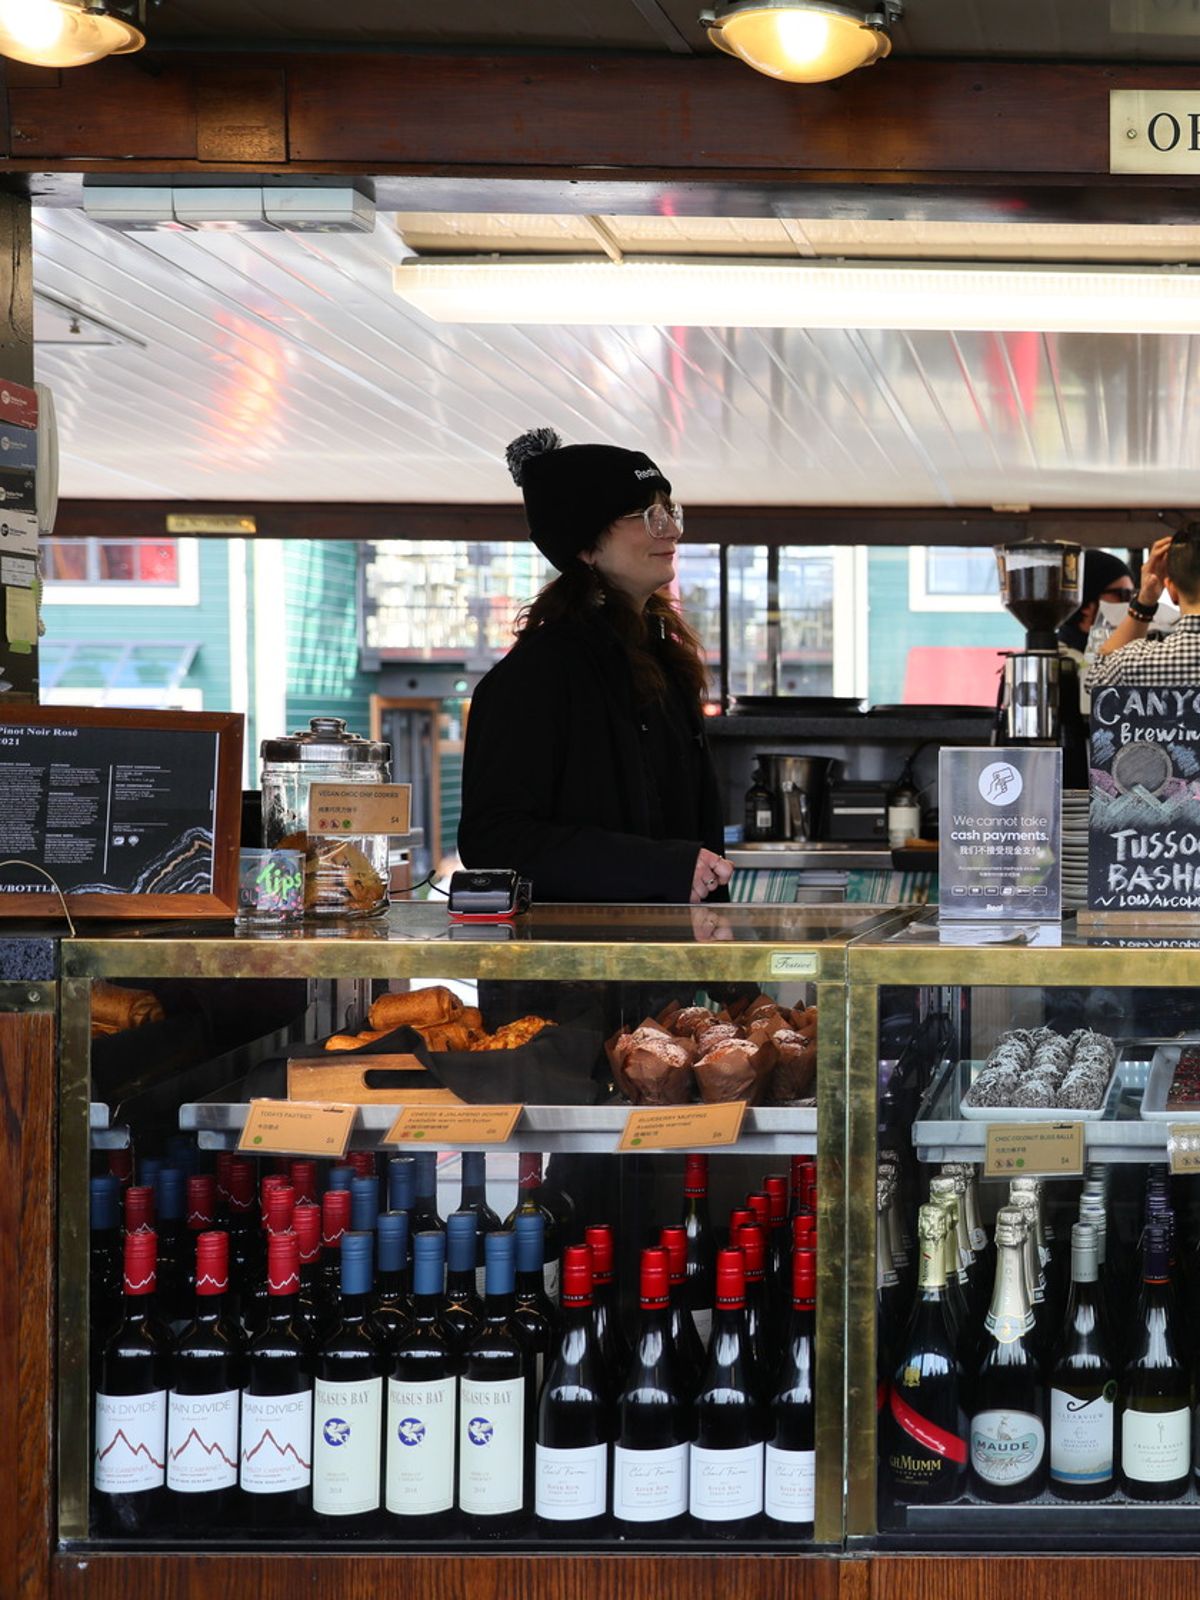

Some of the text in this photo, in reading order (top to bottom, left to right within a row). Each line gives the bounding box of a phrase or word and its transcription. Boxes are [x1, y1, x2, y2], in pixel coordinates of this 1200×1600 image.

[27, 728, 50, 736] Noir
[54, 728, 78, 737] Rosé
[953, 815, 1048, 827] We cannot take
[951, 829, 1050, 843] cash payments.
[256, 862, 302, 901] Tips
[351, 1390, 369, 1405] BAY
[426, 1389, 445, 1405] BAY
[493, 1390, 512, 1405] BAY
[119, 1401, 158, 1414] DIVIDE
[192, 1400, 232, 1414] DIVIDE
[266, 1401, 304, 1415] DIVIDE
[976, 1440, 1030, 1452] MAUDE
